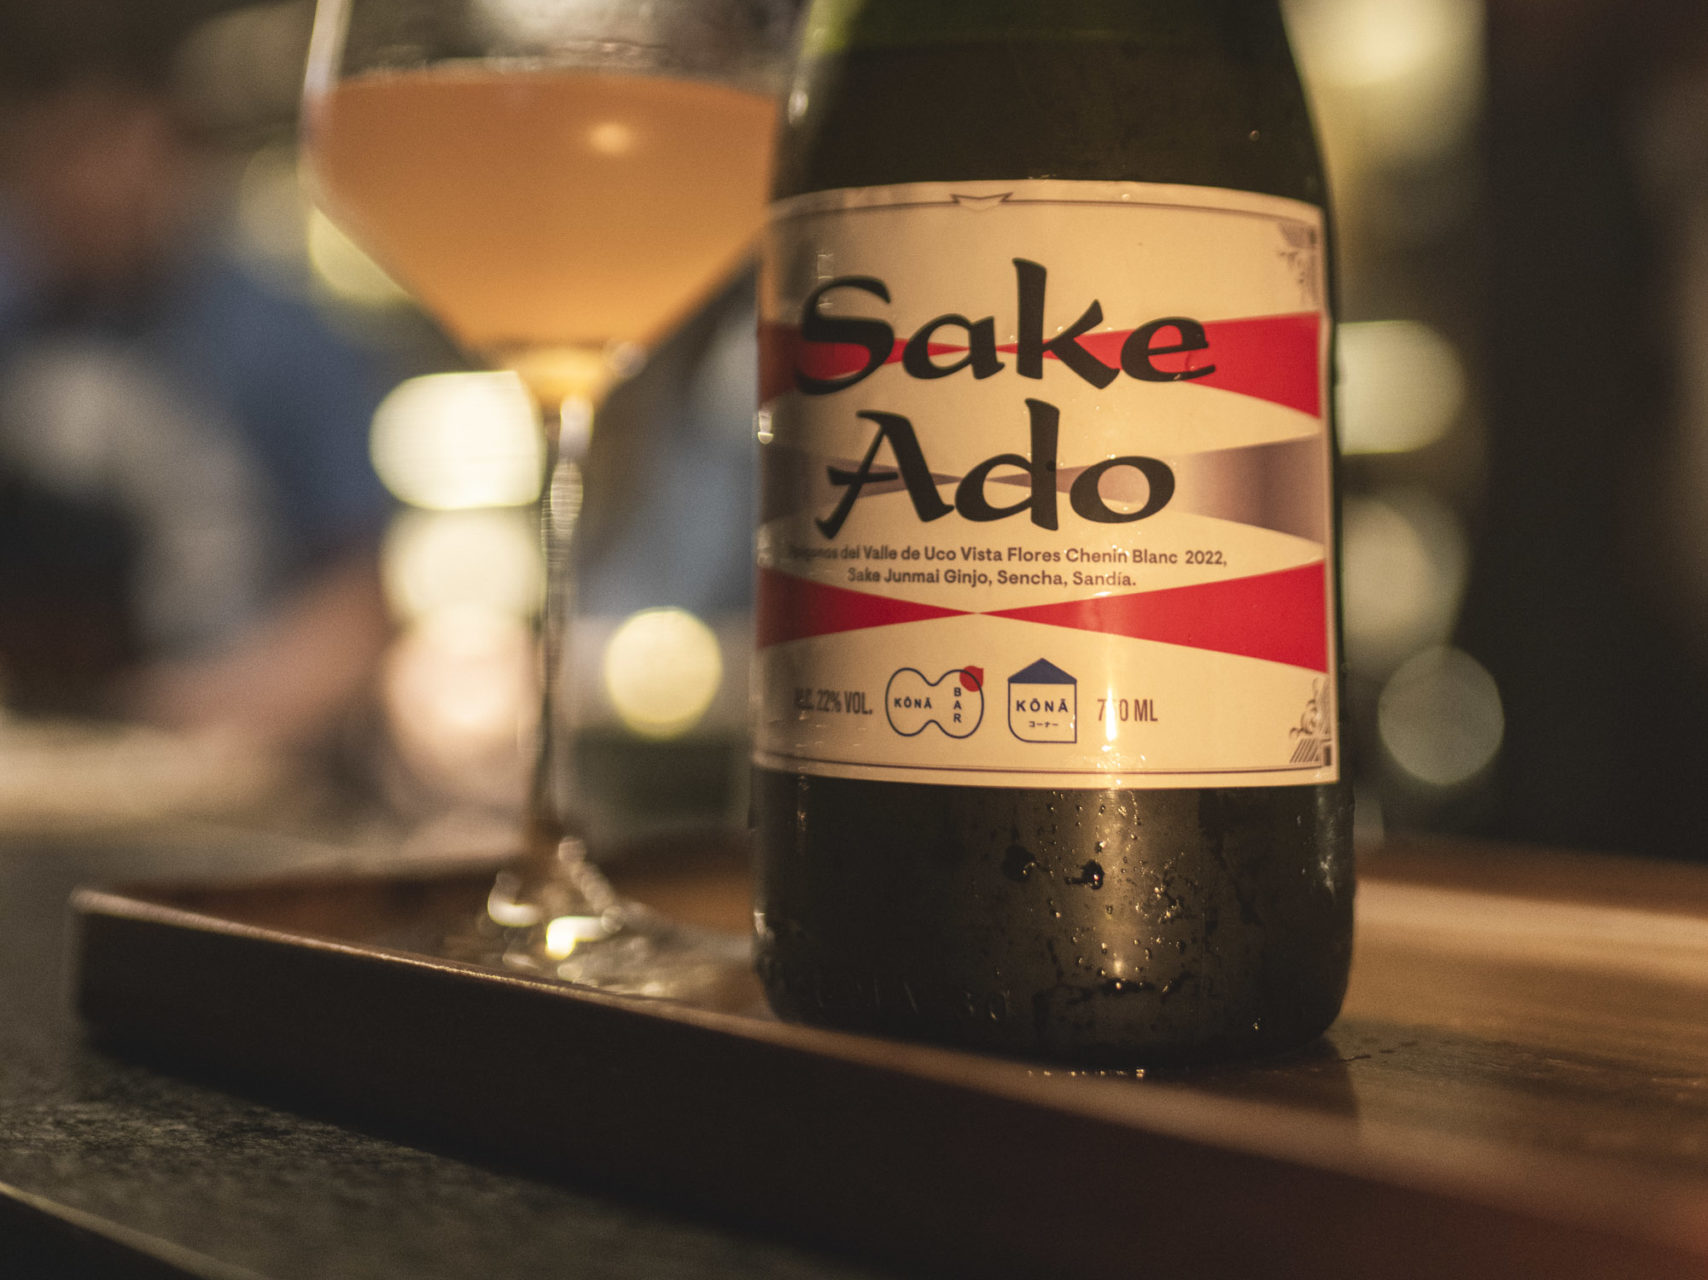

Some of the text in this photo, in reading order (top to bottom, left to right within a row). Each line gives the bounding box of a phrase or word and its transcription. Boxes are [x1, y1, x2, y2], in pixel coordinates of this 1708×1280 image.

[796, 257, 1216, 396] Sake
[815, 398, 1176, 540] Ado
[840, 545, 860, 560] del
[863, 545, 898, 561] Valle
[901, 545, 921, 561] de
[924, 546, 957, 562] Uco
[960, 547, 1002, 562] Vista
[1007, 547, 1061, 563] Flores
[1065, 547, 1129, 564] Chenin
[1132, 549, 1178, 565] Blanc
[1185, 550, 1227, 567] 2022,
[848, 567, 1136, 588] Sake Junmai Ginjo, Sencha, Sandía.
[817, 689, 842, 713] 22%
[844, 691, 873, 715] VOL.
[953, 686, 962, 724] BAR
[1097, 698, 1158, 722] 70 ML
[1028, 720, 1059, 728] コーナー
